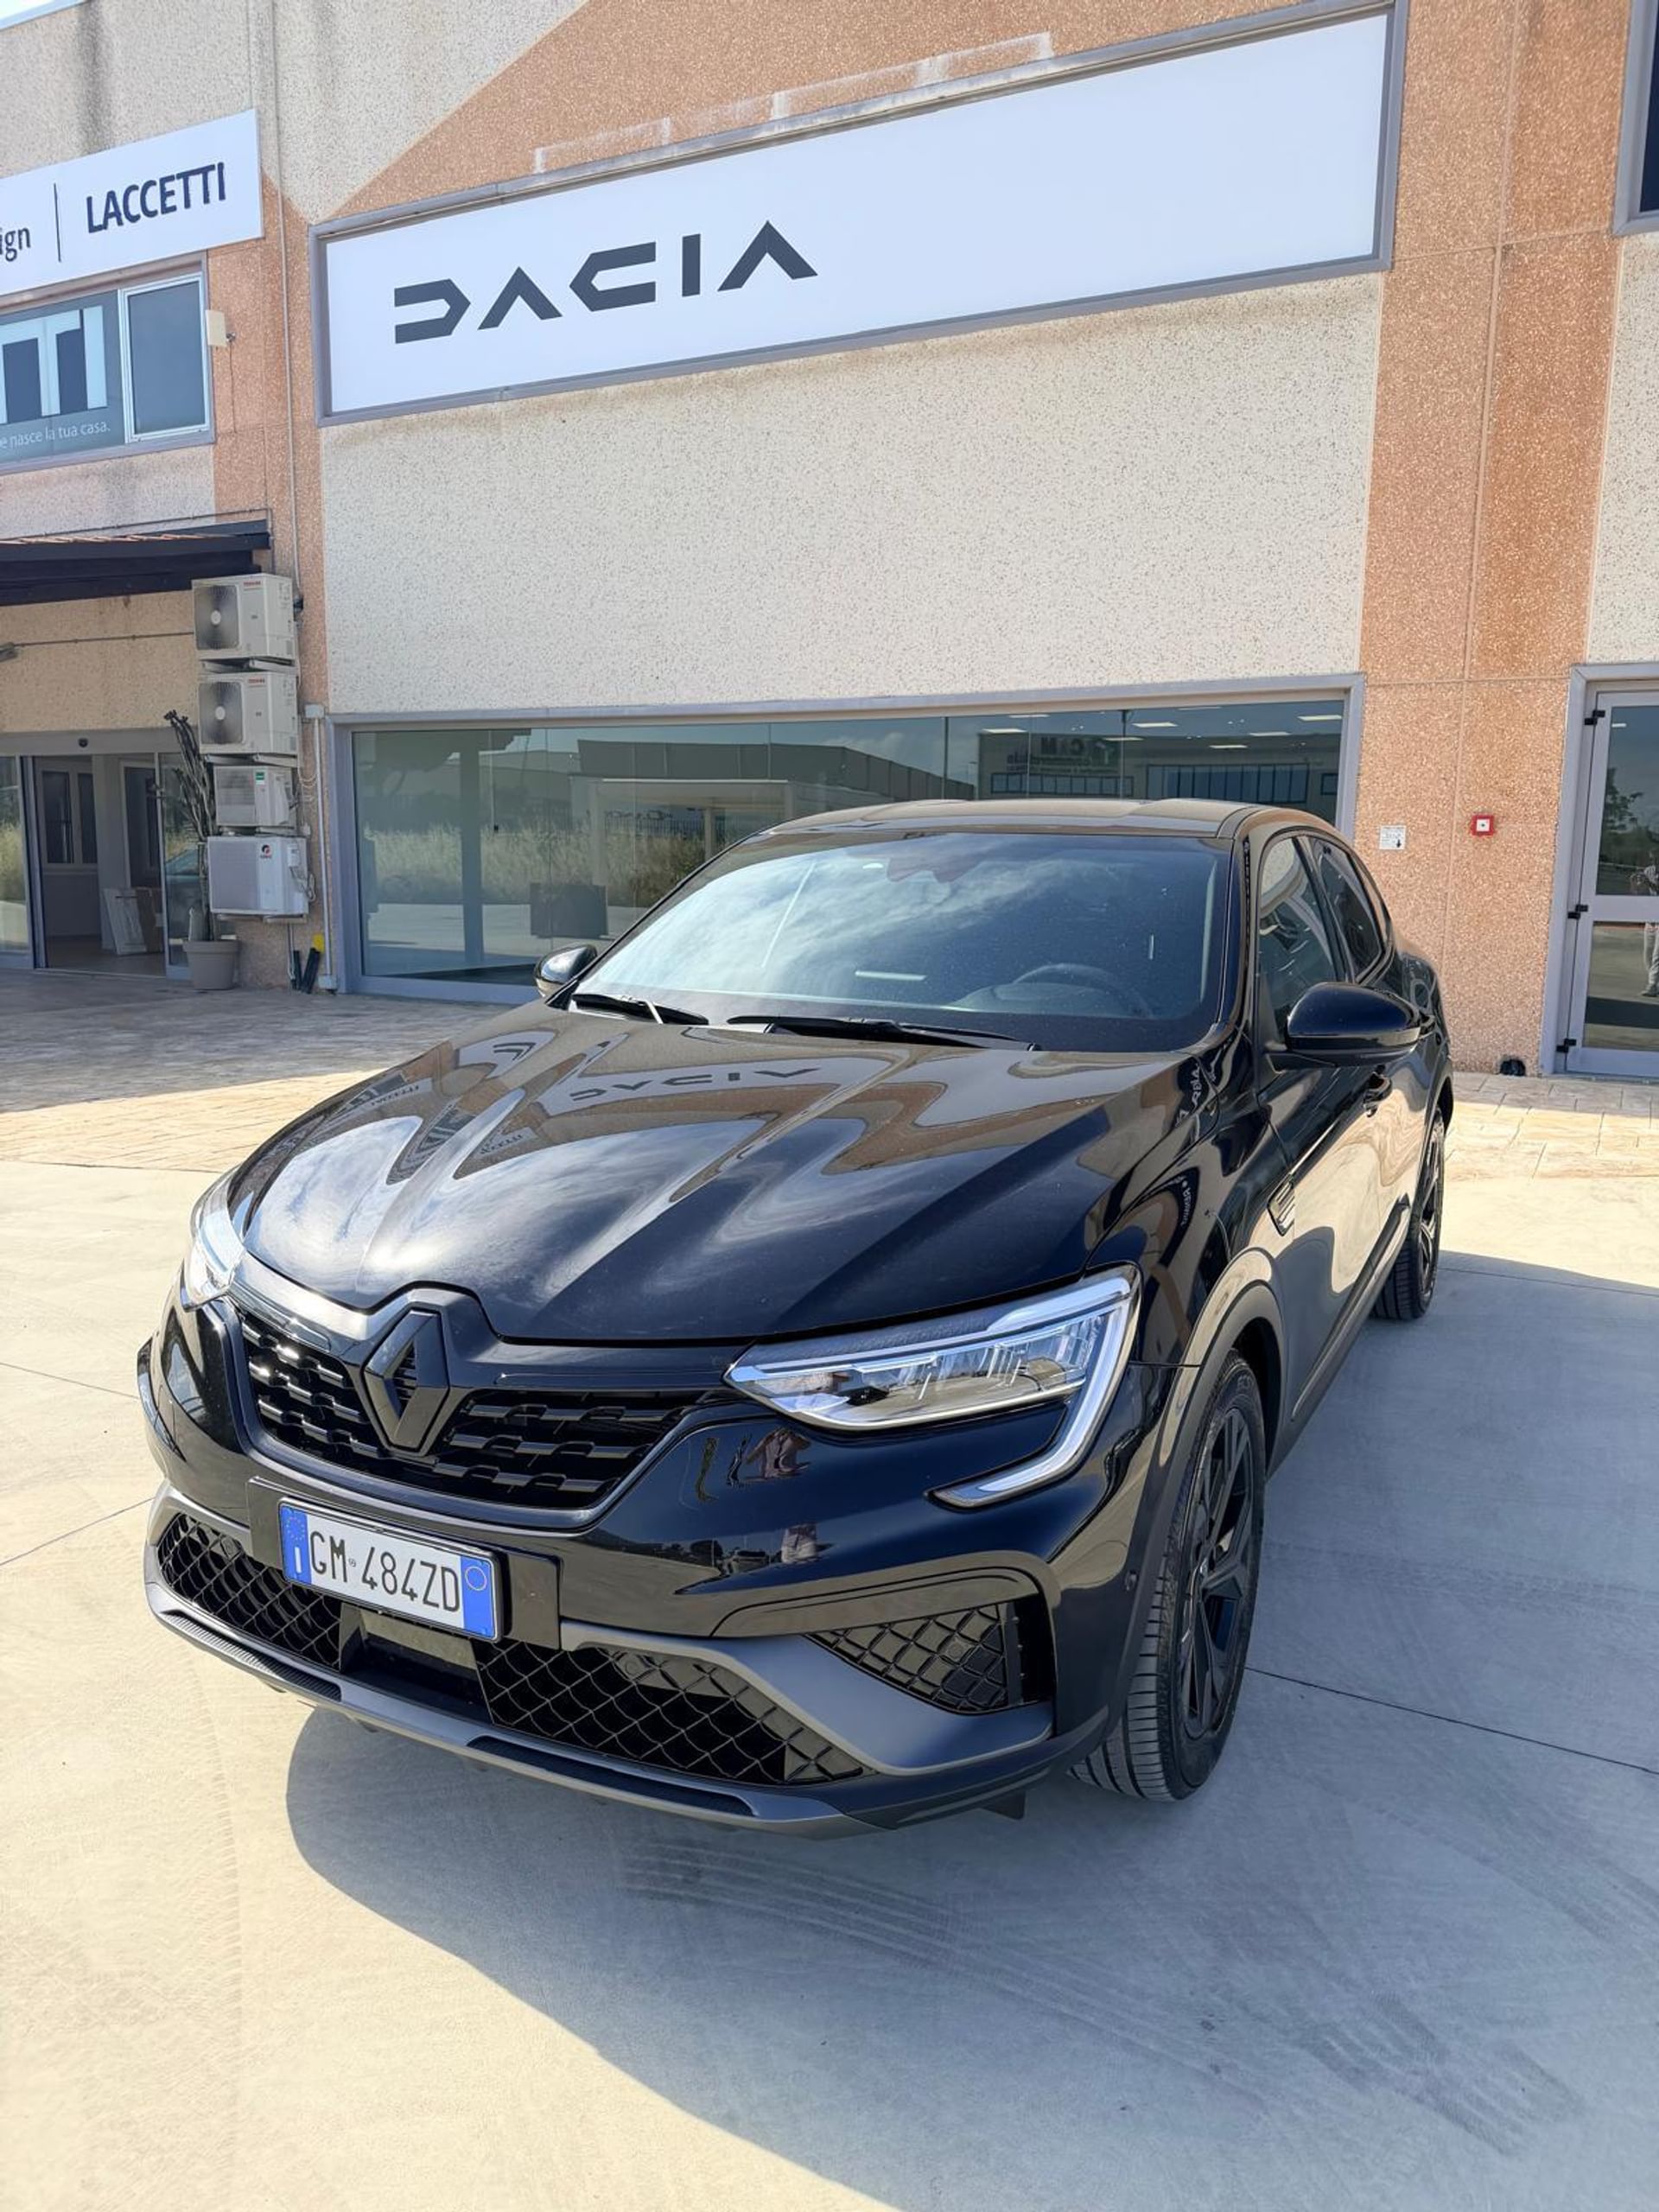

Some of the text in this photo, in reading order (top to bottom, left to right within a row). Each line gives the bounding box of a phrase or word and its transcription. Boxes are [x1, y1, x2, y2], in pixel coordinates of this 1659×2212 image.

[86, 162, 226, 233] LACCETTI
[394, 220, 818, 344] DACIA
[10, 431, 43, 449] nasce
[45, 425, 55, 442] la
[59, 425, 78, 439] tua
[79, 421, 111, 435] casa.
[309, 1530, 348, 1583] GM
[361, 1546, 461, 1613] 484ZD
